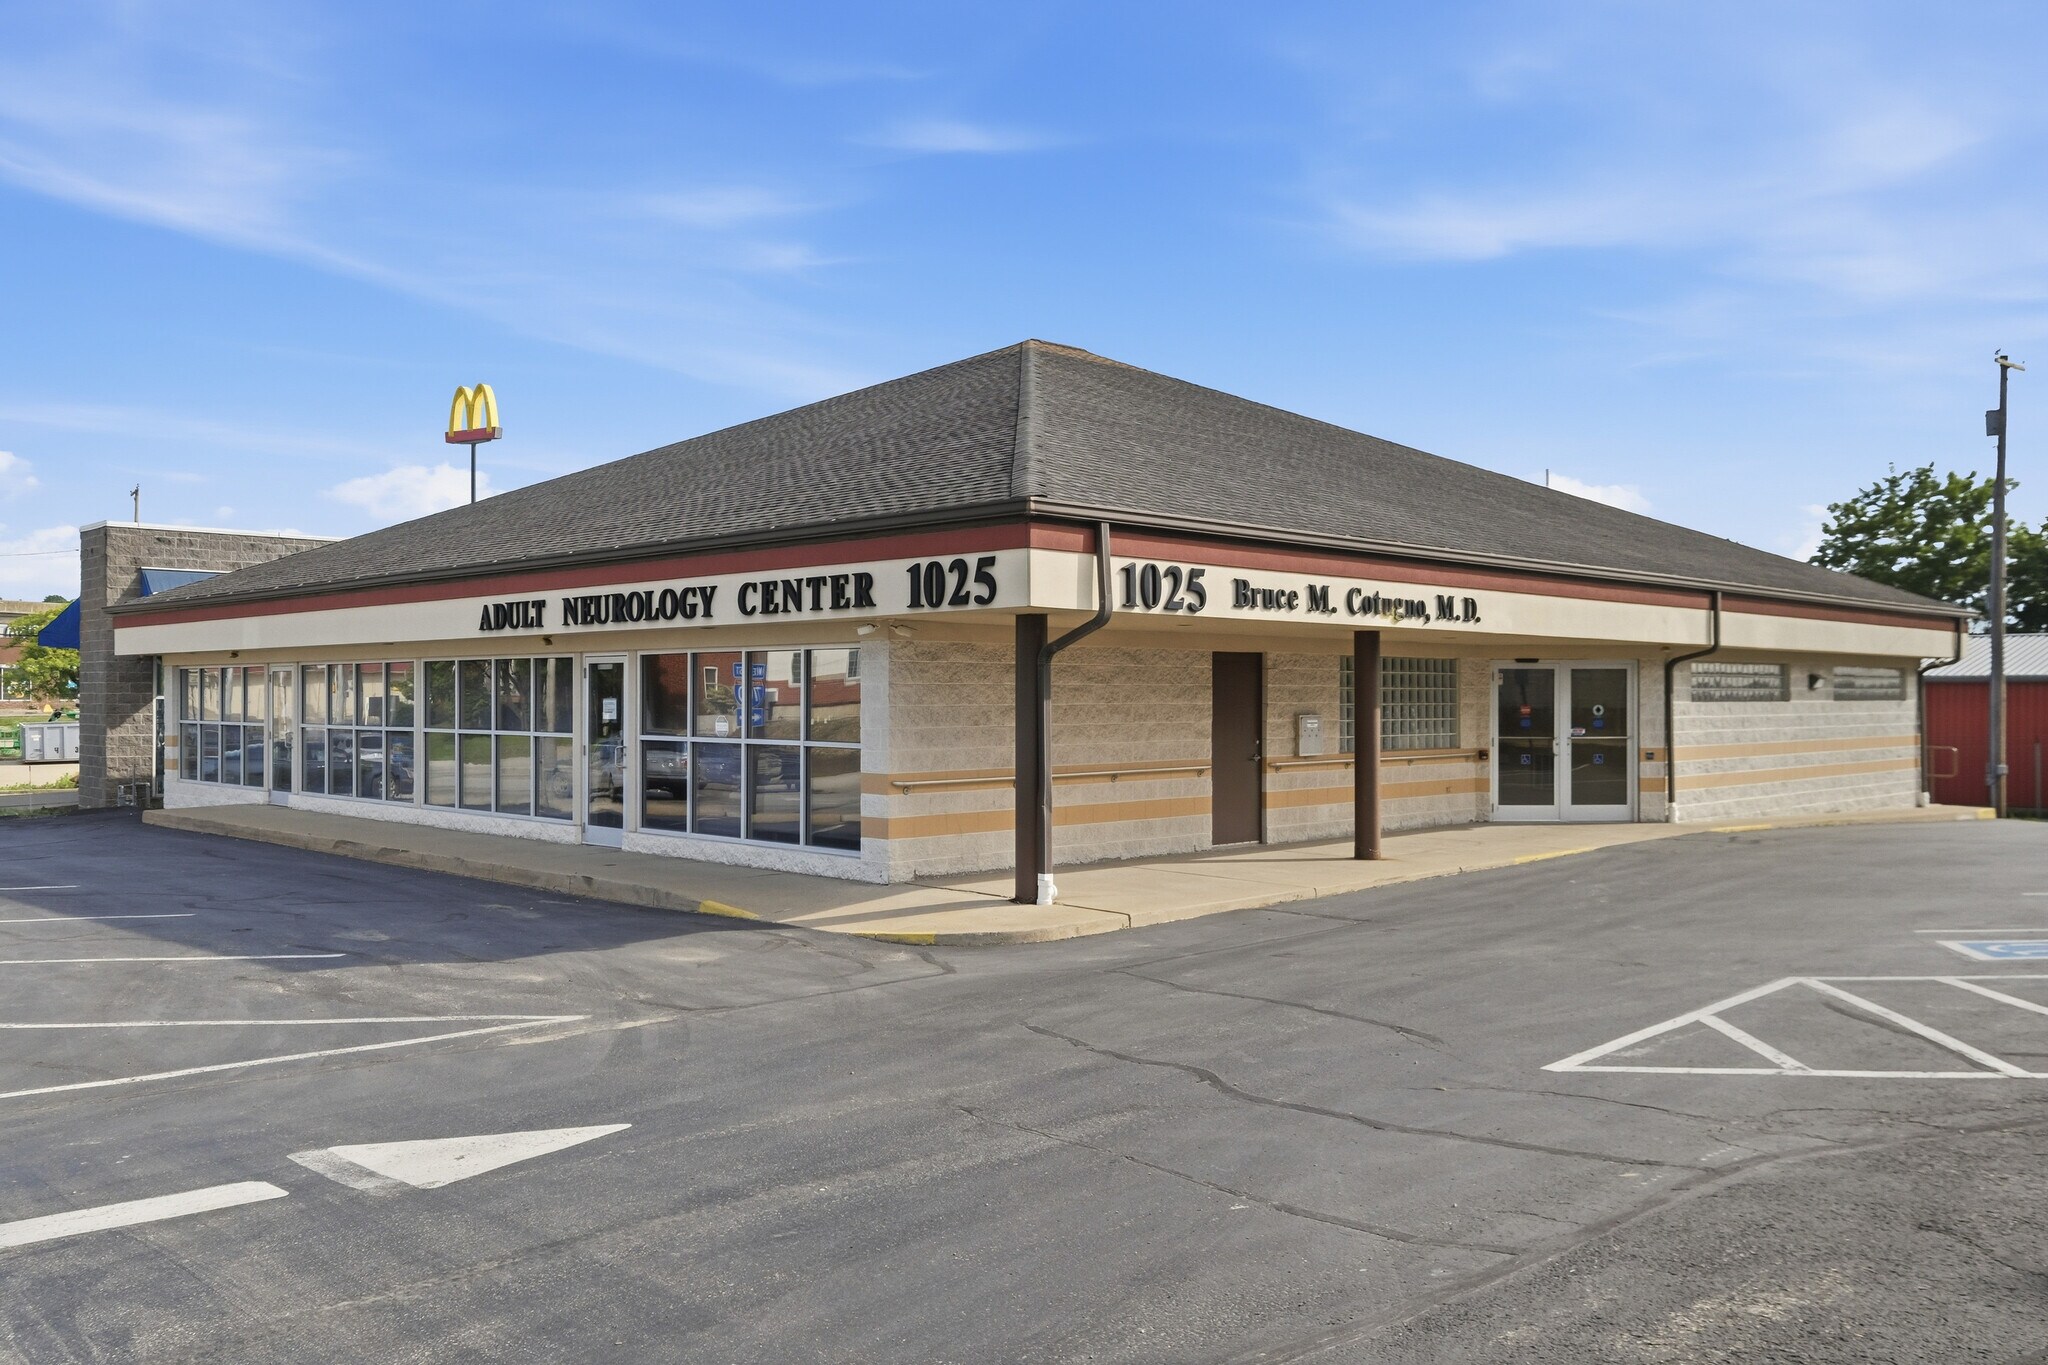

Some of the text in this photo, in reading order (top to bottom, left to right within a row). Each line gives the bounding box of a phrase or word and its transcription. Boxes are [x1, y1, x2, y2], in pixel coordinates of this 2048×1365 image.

[479, 555, 997, 631] ADULT NEUROLOGY CENTER 1025
[1120, 562, 1482, 626] 1025 Bruce M. Cotugno, M.D.
